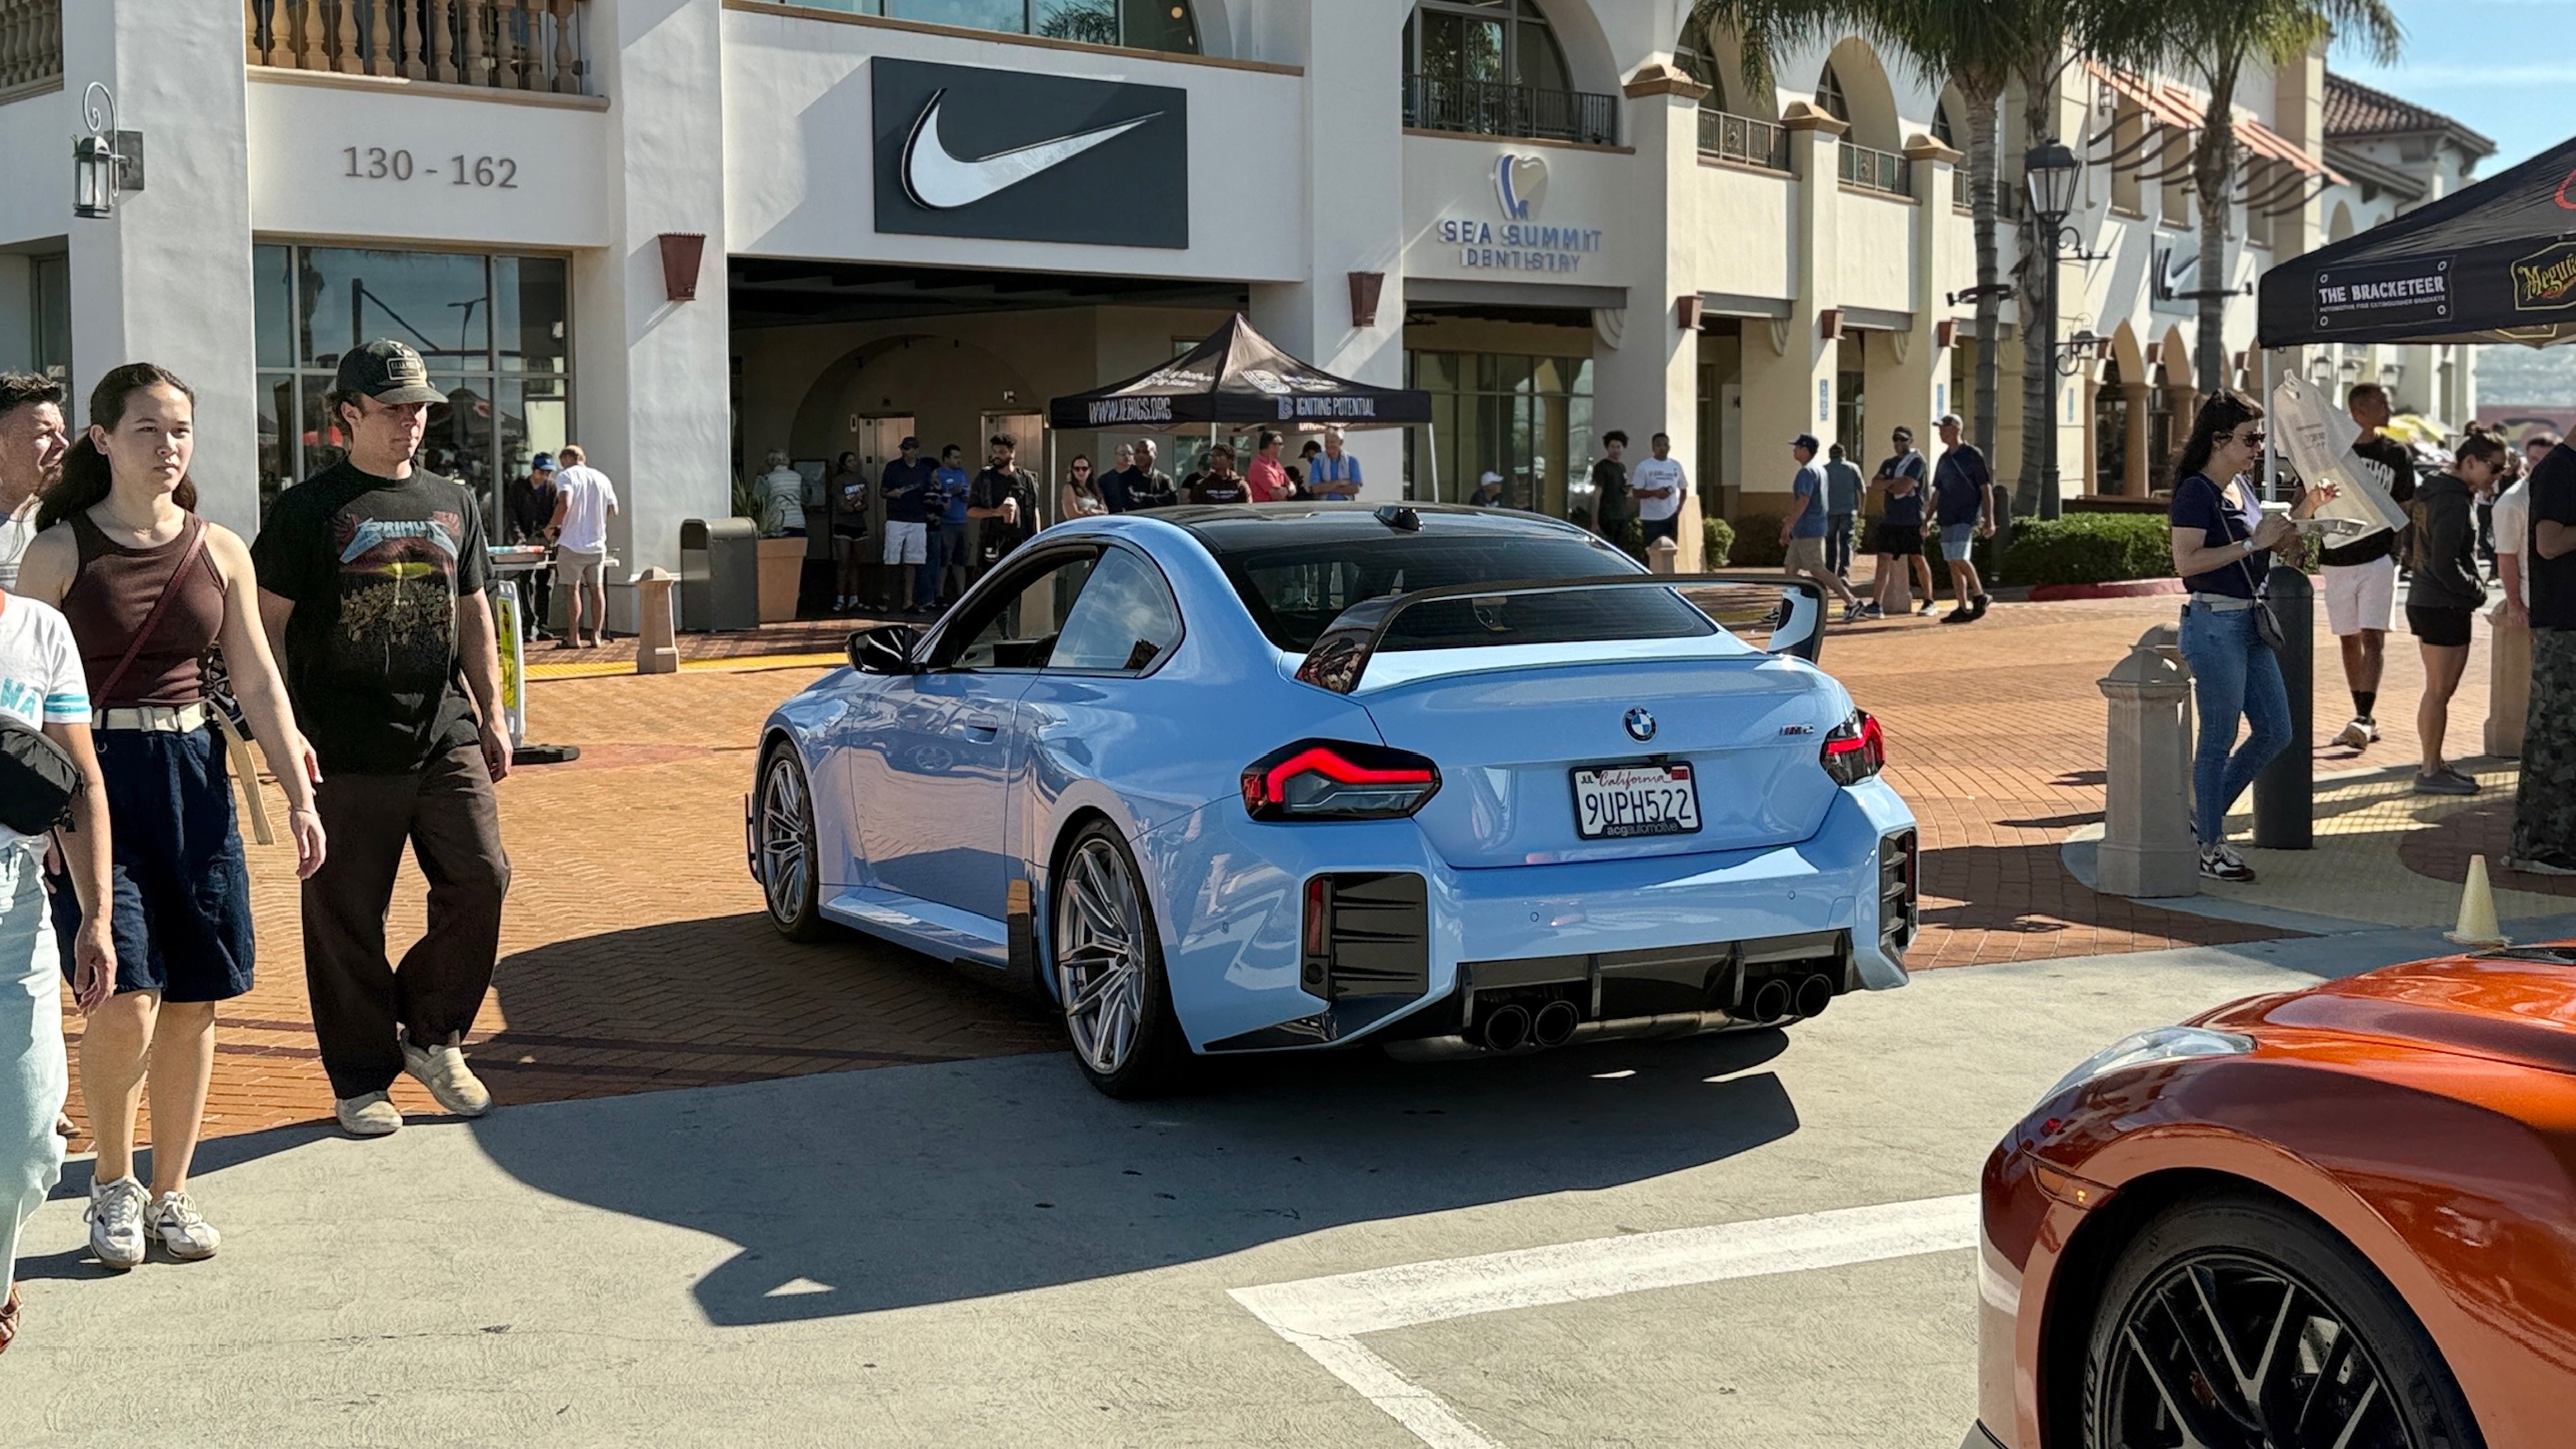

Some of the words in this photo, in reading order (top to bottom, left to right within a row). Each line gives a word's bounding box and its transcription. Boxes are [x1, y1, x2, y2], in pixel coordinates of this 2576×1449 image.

[343, 146, 413, 181] 130
[451, 155, 518, 189] 162
[1440, 220, 1492, 244] SEA
[1502, 225, 1602, 252] SUMMIT
[1462, 247, 1581, 273] DENTISTRY
[2318, 287, 2347, 304] THE
[2351, 275, 2446, 301] BRACKETEER
[1296, 397, 1331, 416] IGNITING
[1332, 397, 1376, 416] POTENTIAL
[1598, 770, 1670, 791] California
[1585, 788, 1692, 826] 9UPH522
